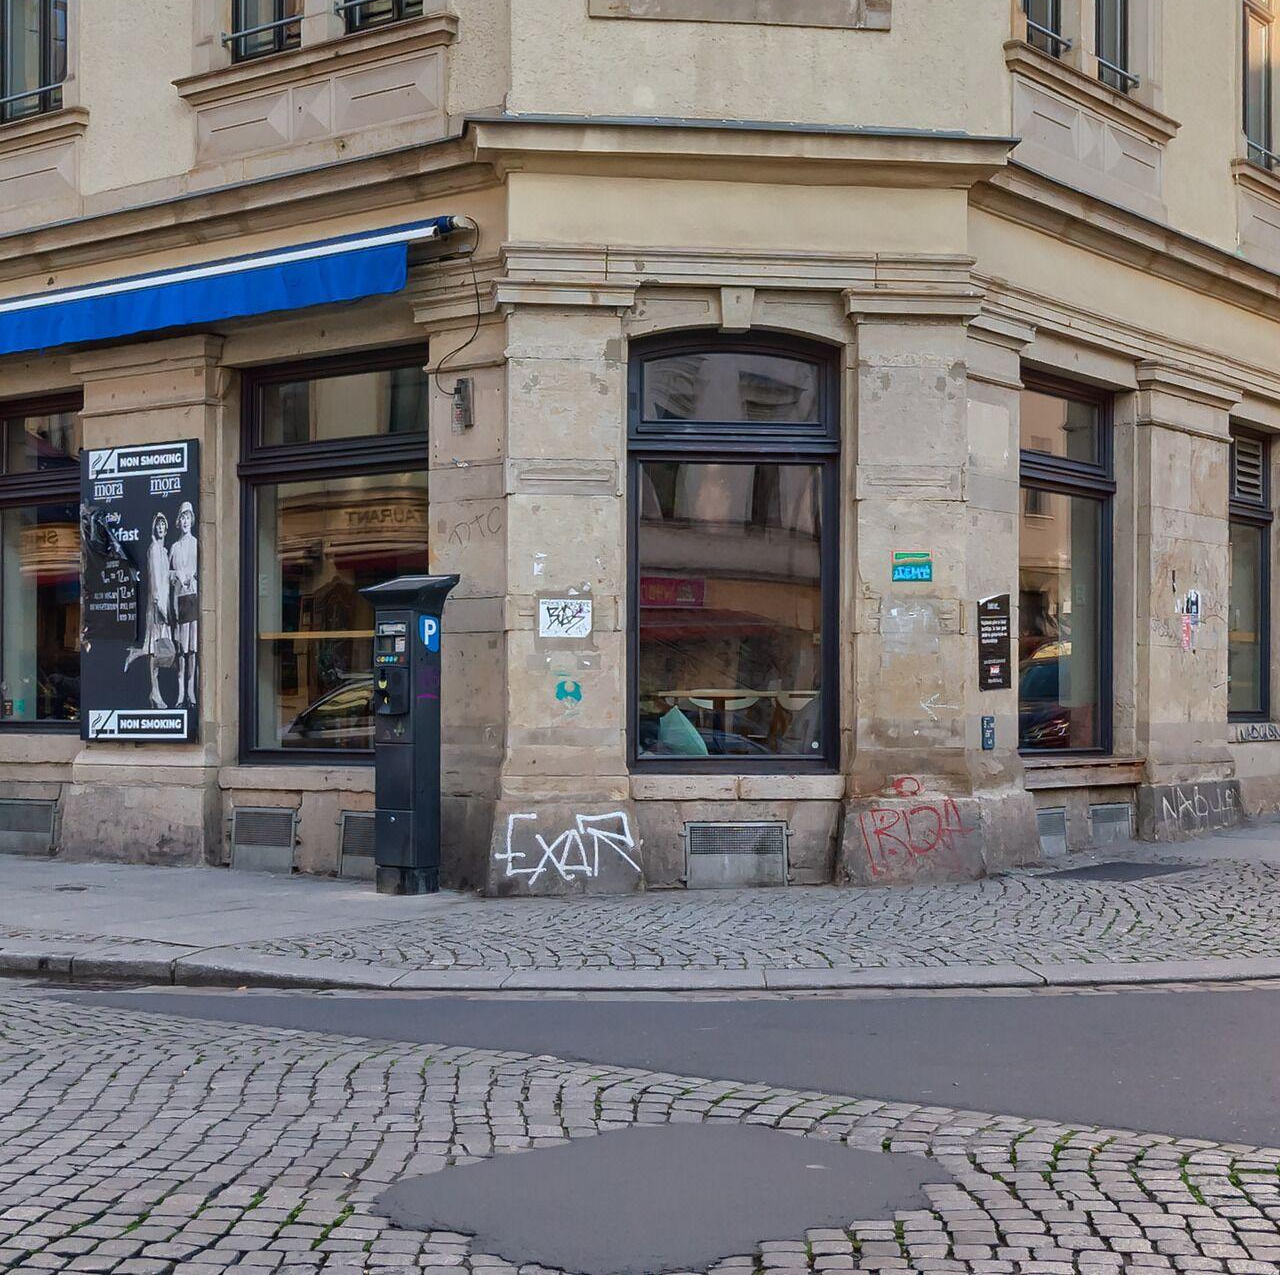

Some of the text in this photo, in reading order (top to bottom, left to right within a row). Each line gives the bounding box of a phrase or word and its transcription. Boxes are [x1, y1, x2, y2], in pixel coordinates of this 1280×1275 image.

[120, 453, 182, 467] NON SMOKING
[94, 482, 123, 497] mora
[150, 477, 181, 491] mora
[111, 527, 140, 541] kfast
[424, 620, 437, 645] P
[120, 719, 182, 729] NON SMOKING
